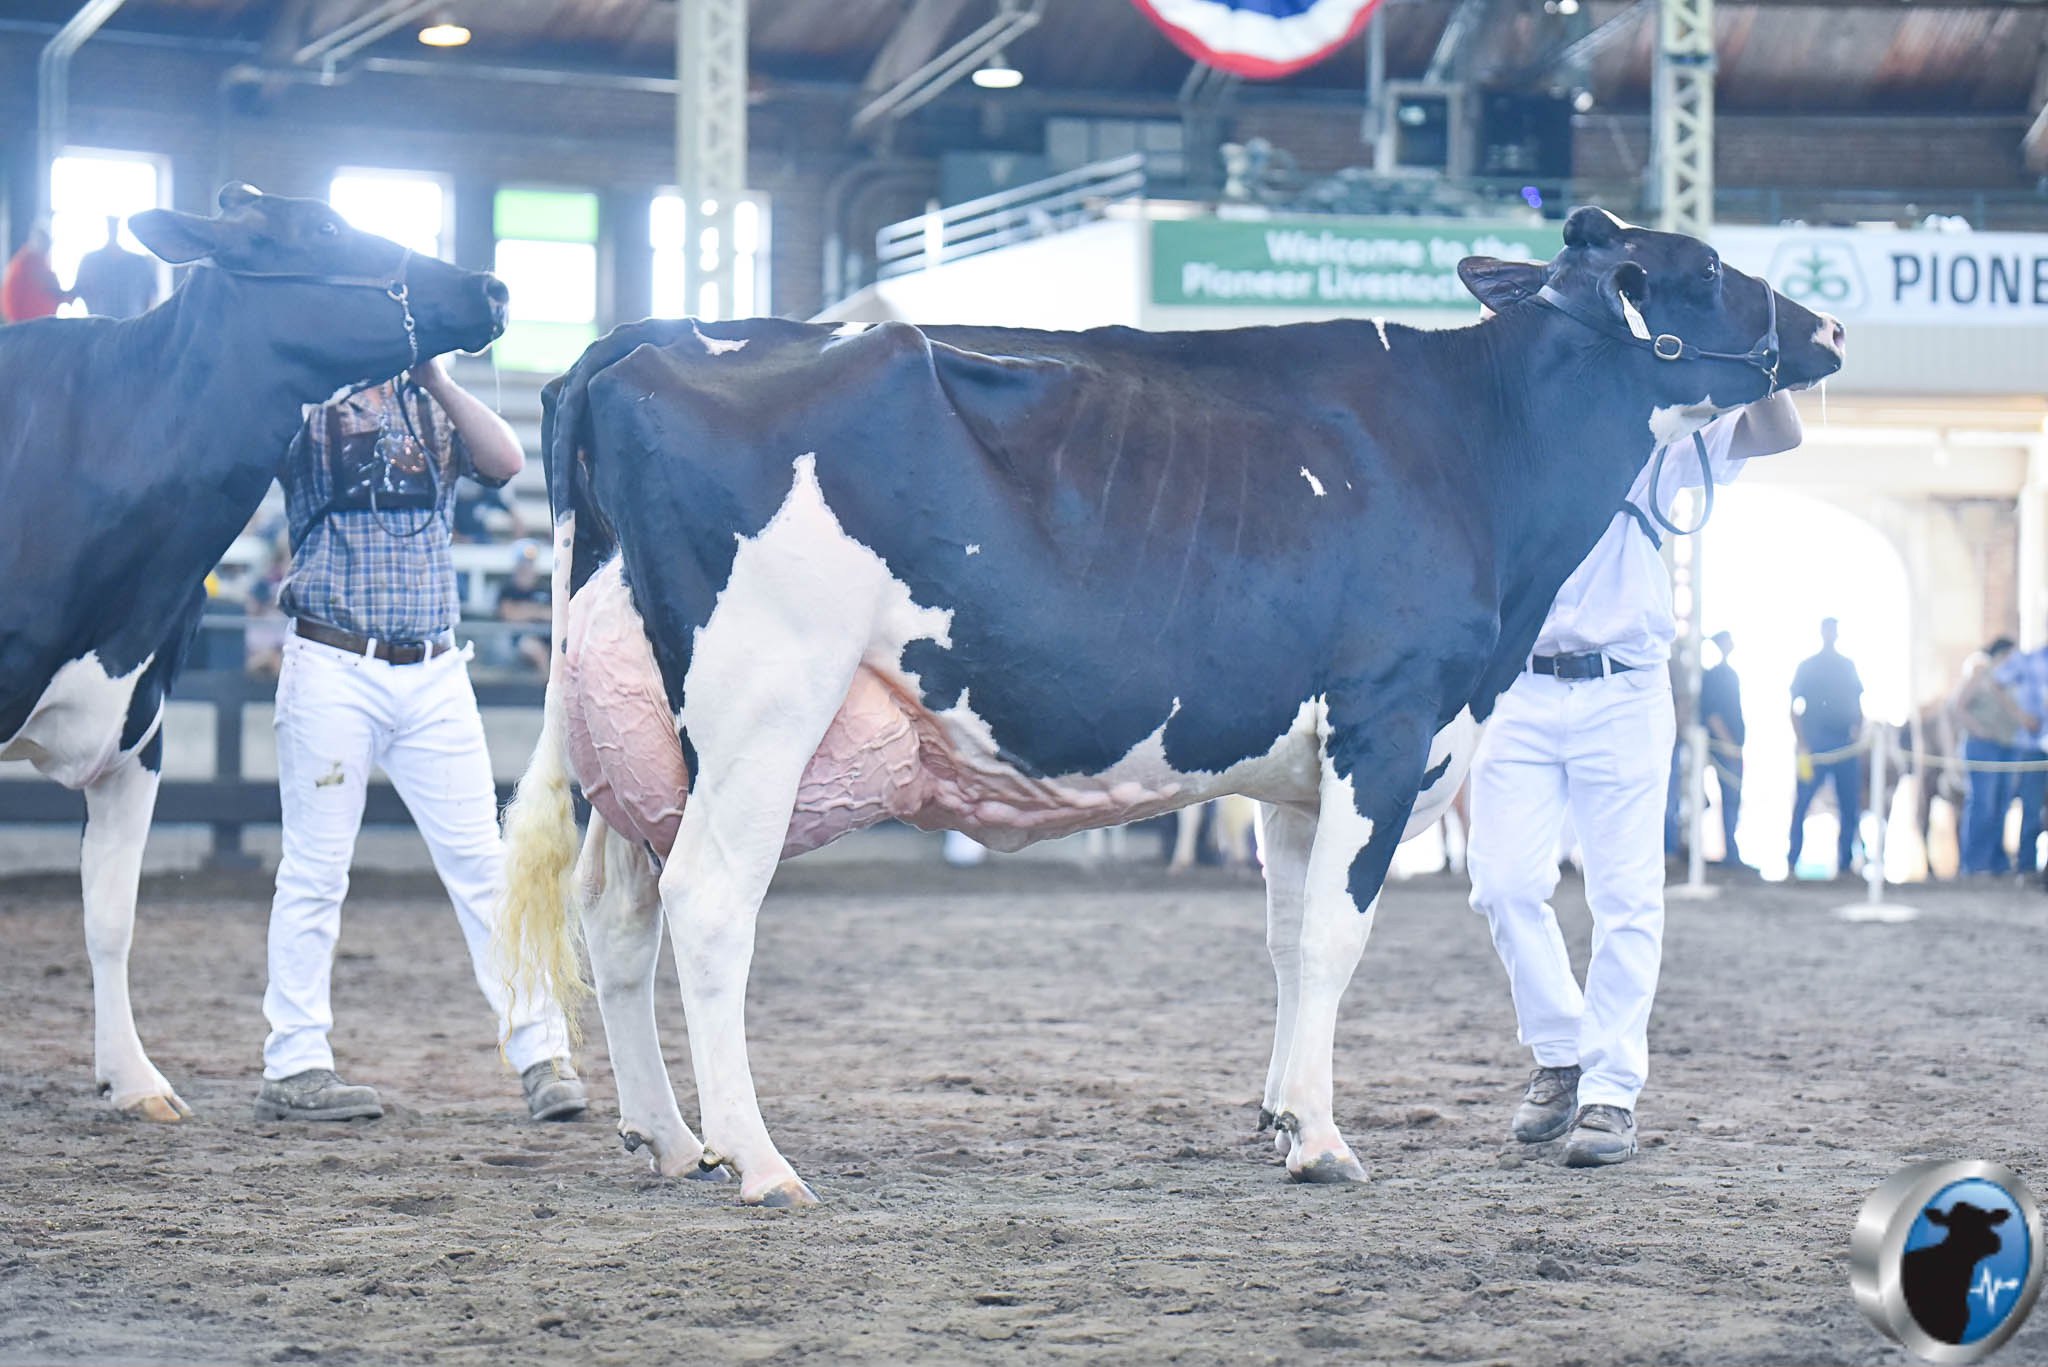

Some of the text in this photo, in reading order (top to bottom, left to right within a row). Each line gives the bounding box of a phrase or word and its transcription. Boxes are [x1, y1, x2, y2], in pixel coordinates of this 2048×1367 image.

[1266, 230, 1531, 268] Welcome to the
[1182, 262, 1312, 298] Pioneer
[1891, 254, 2048, 304] PIONE
